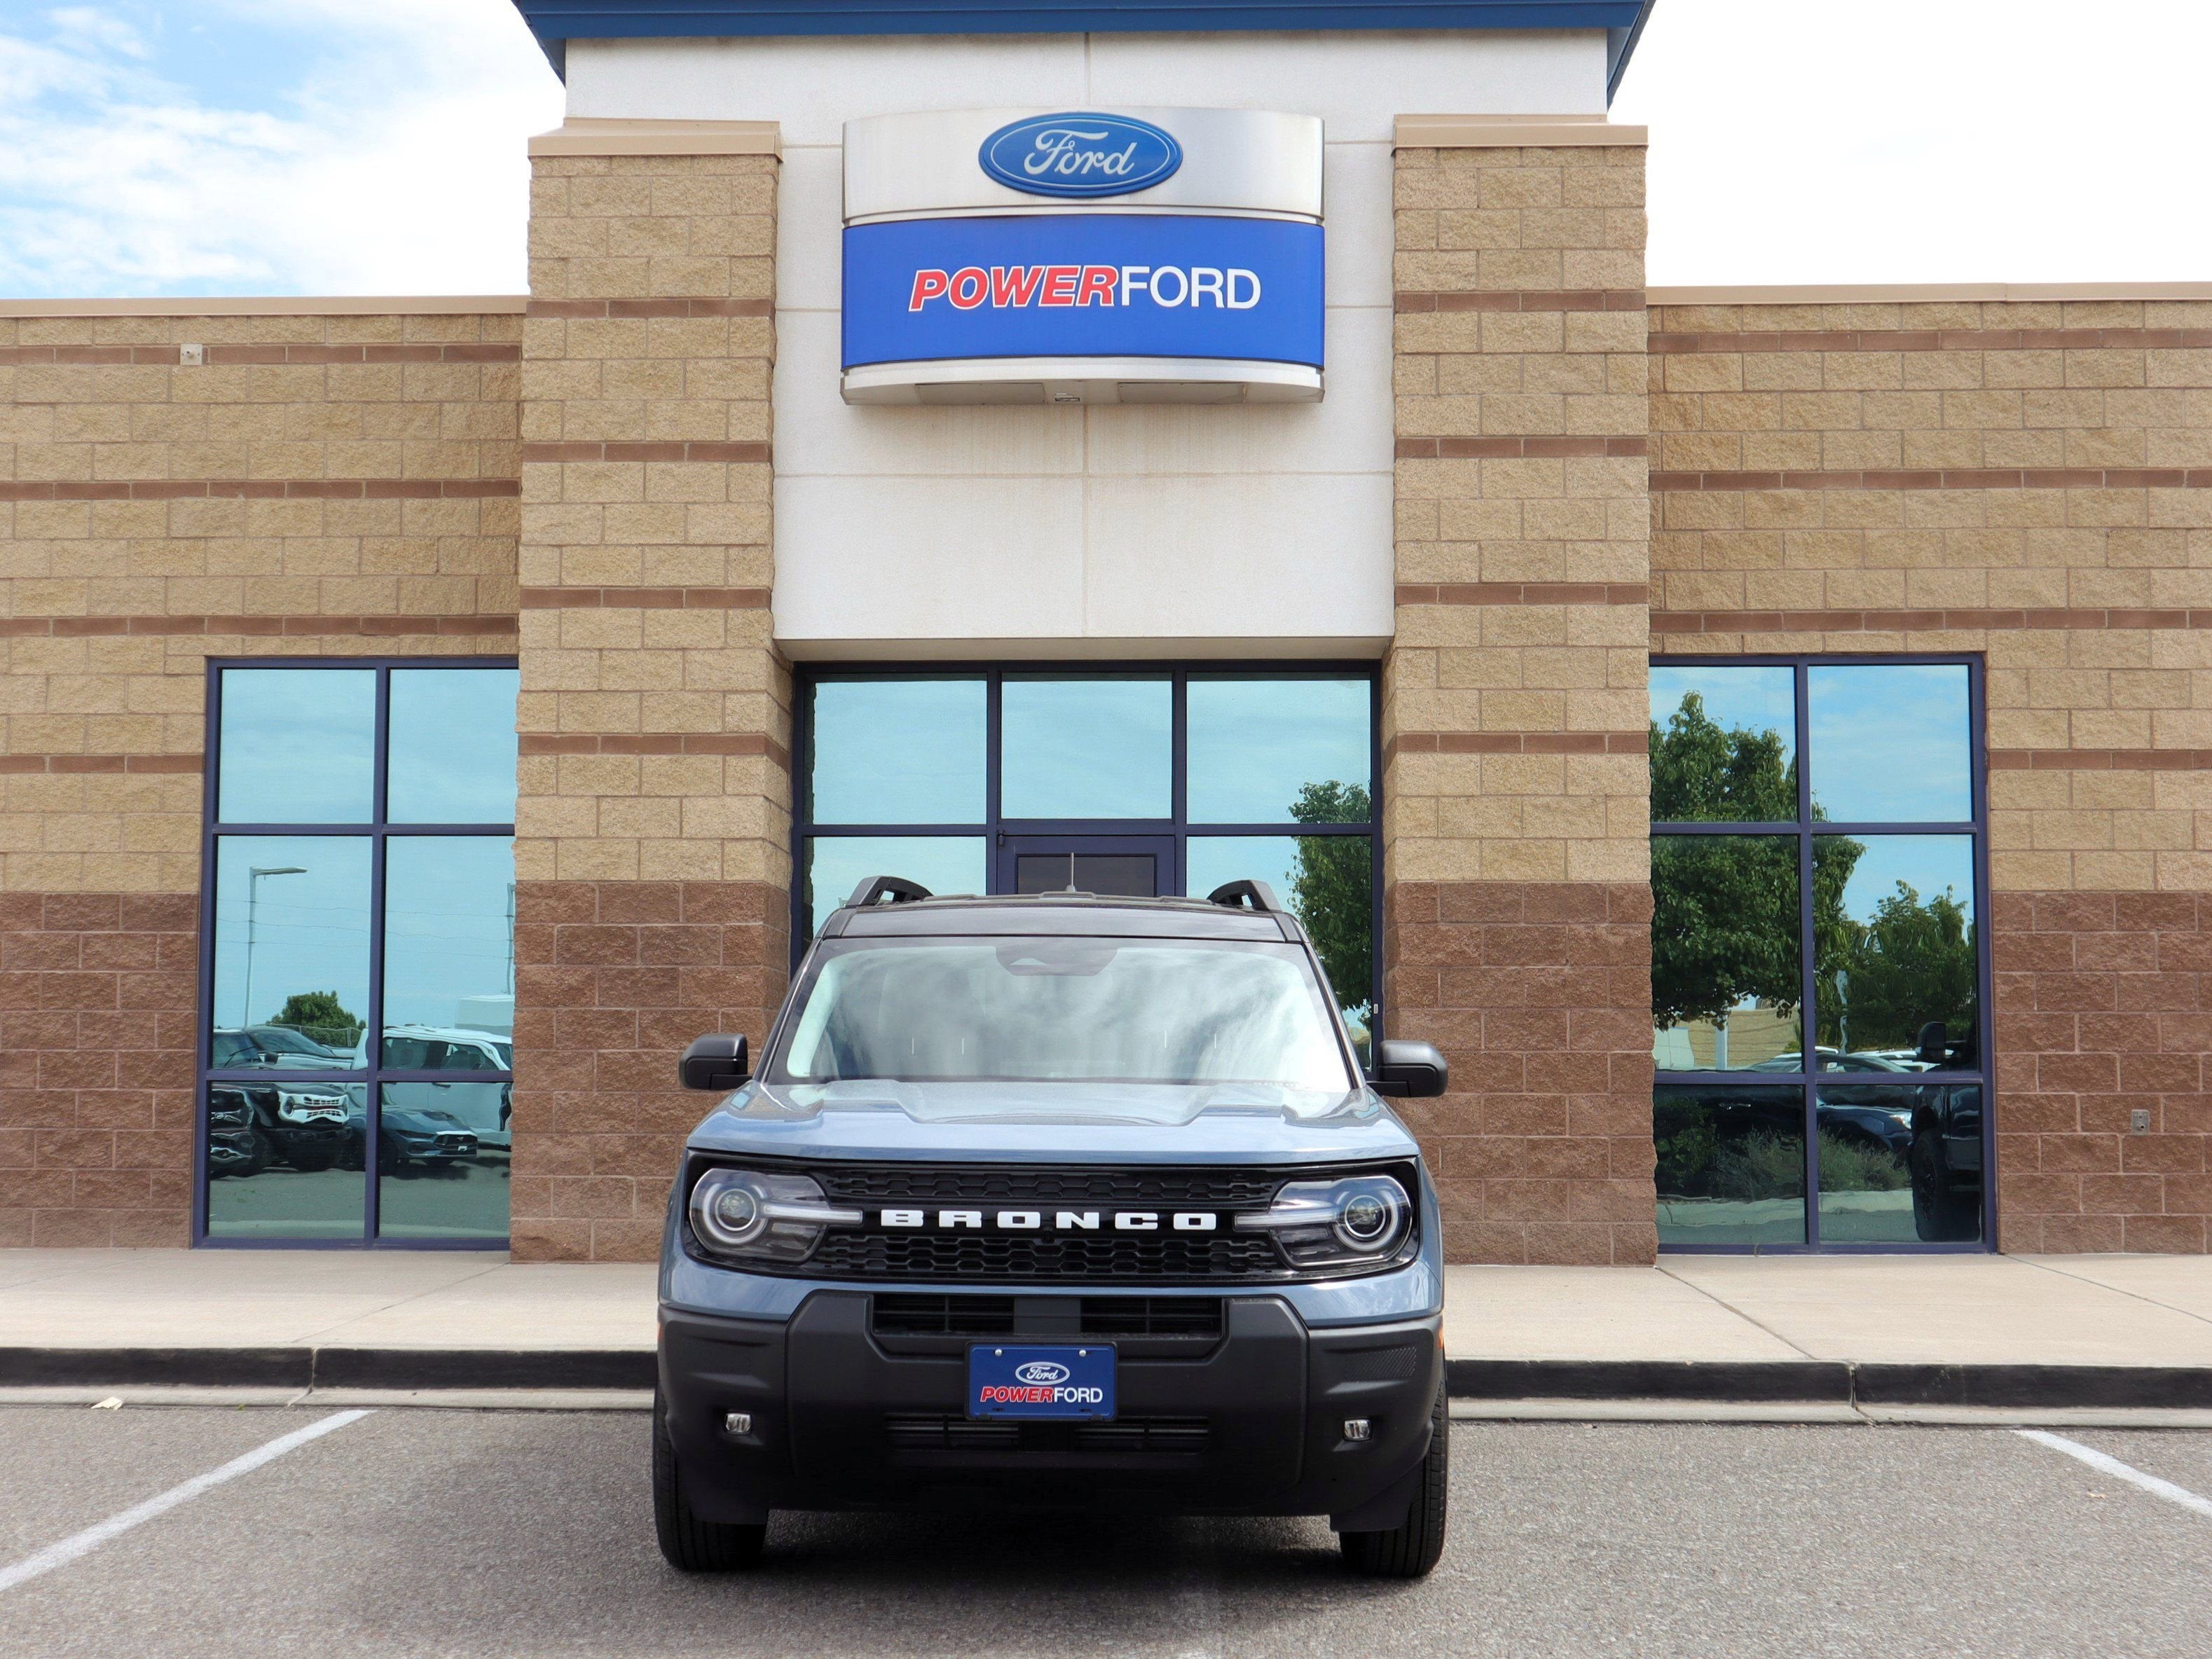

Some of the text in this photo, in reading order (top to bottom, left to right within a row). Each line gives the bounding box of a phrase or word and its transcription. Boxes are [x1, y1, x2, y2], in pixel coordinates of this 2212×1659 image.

[1024, 128, 1137, 175] Ford
[881, 1209, 1216, 1230] BRONCO
[1026, 1365, 1058, 1380] Ford
